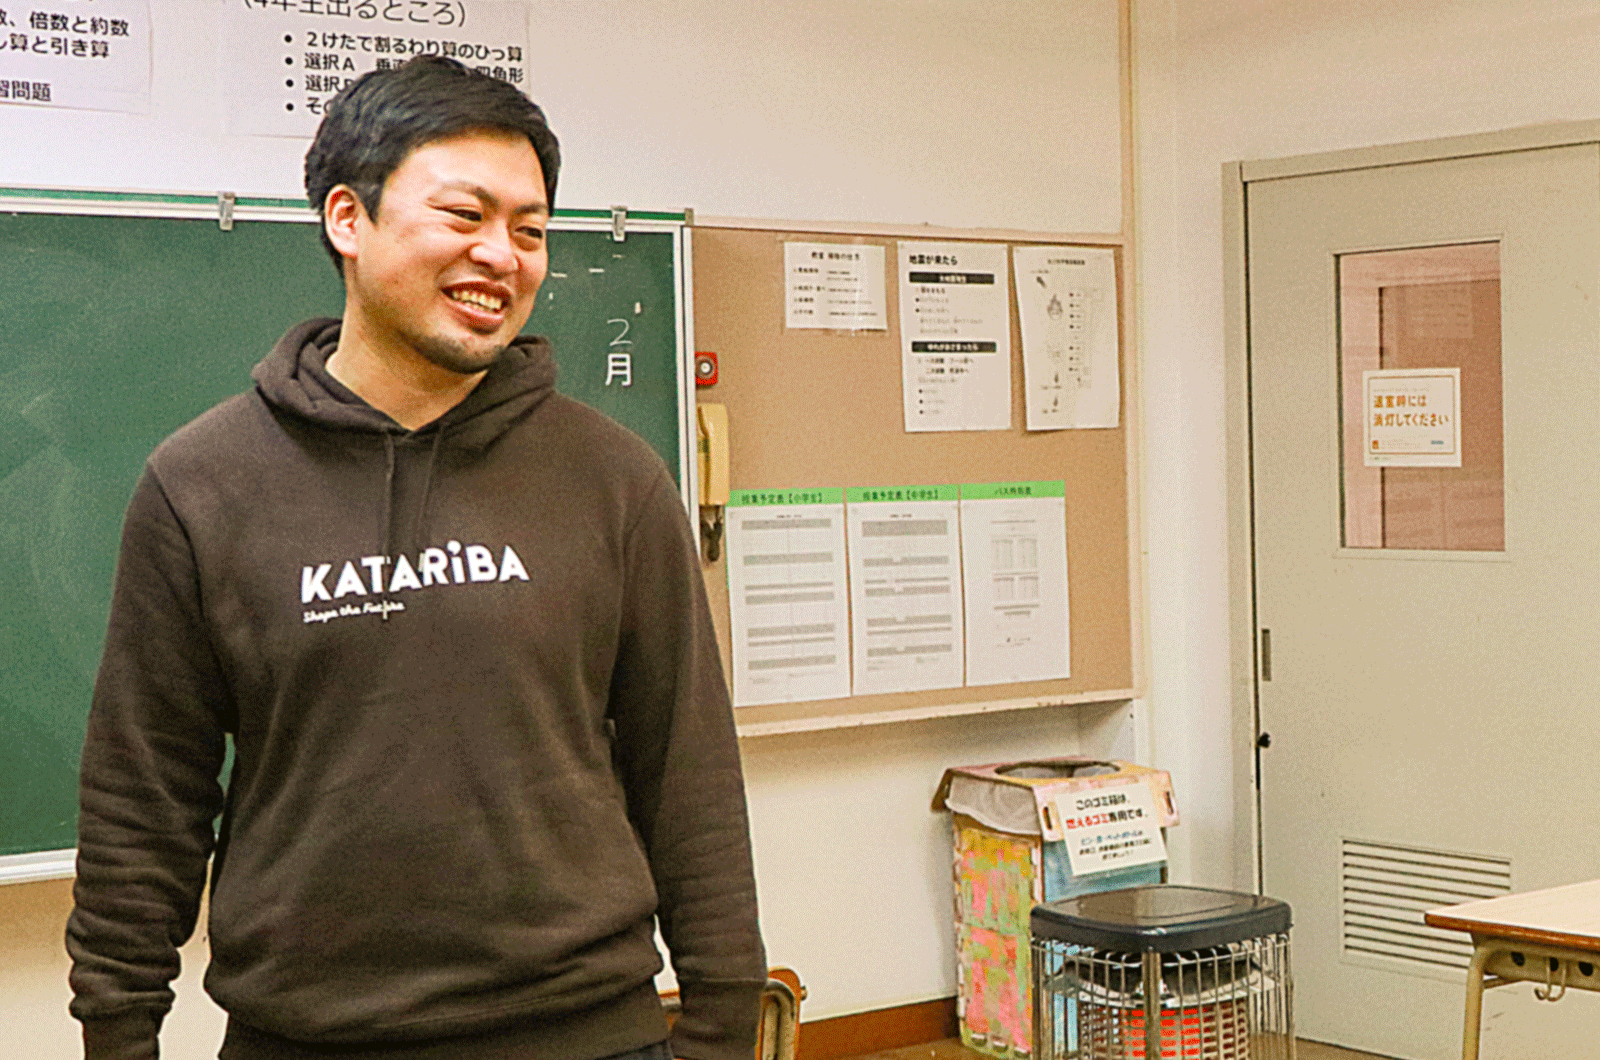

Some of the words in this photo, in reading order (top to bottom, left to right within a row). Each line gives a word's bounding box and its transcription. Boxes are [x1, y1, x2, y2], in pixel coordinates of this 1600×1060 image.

[909, 254, 958, 266] 地震が来たら
[1373, 394, 1428, 409] 退室時には
[1373, 413, 1450, 428] 消灯してください
